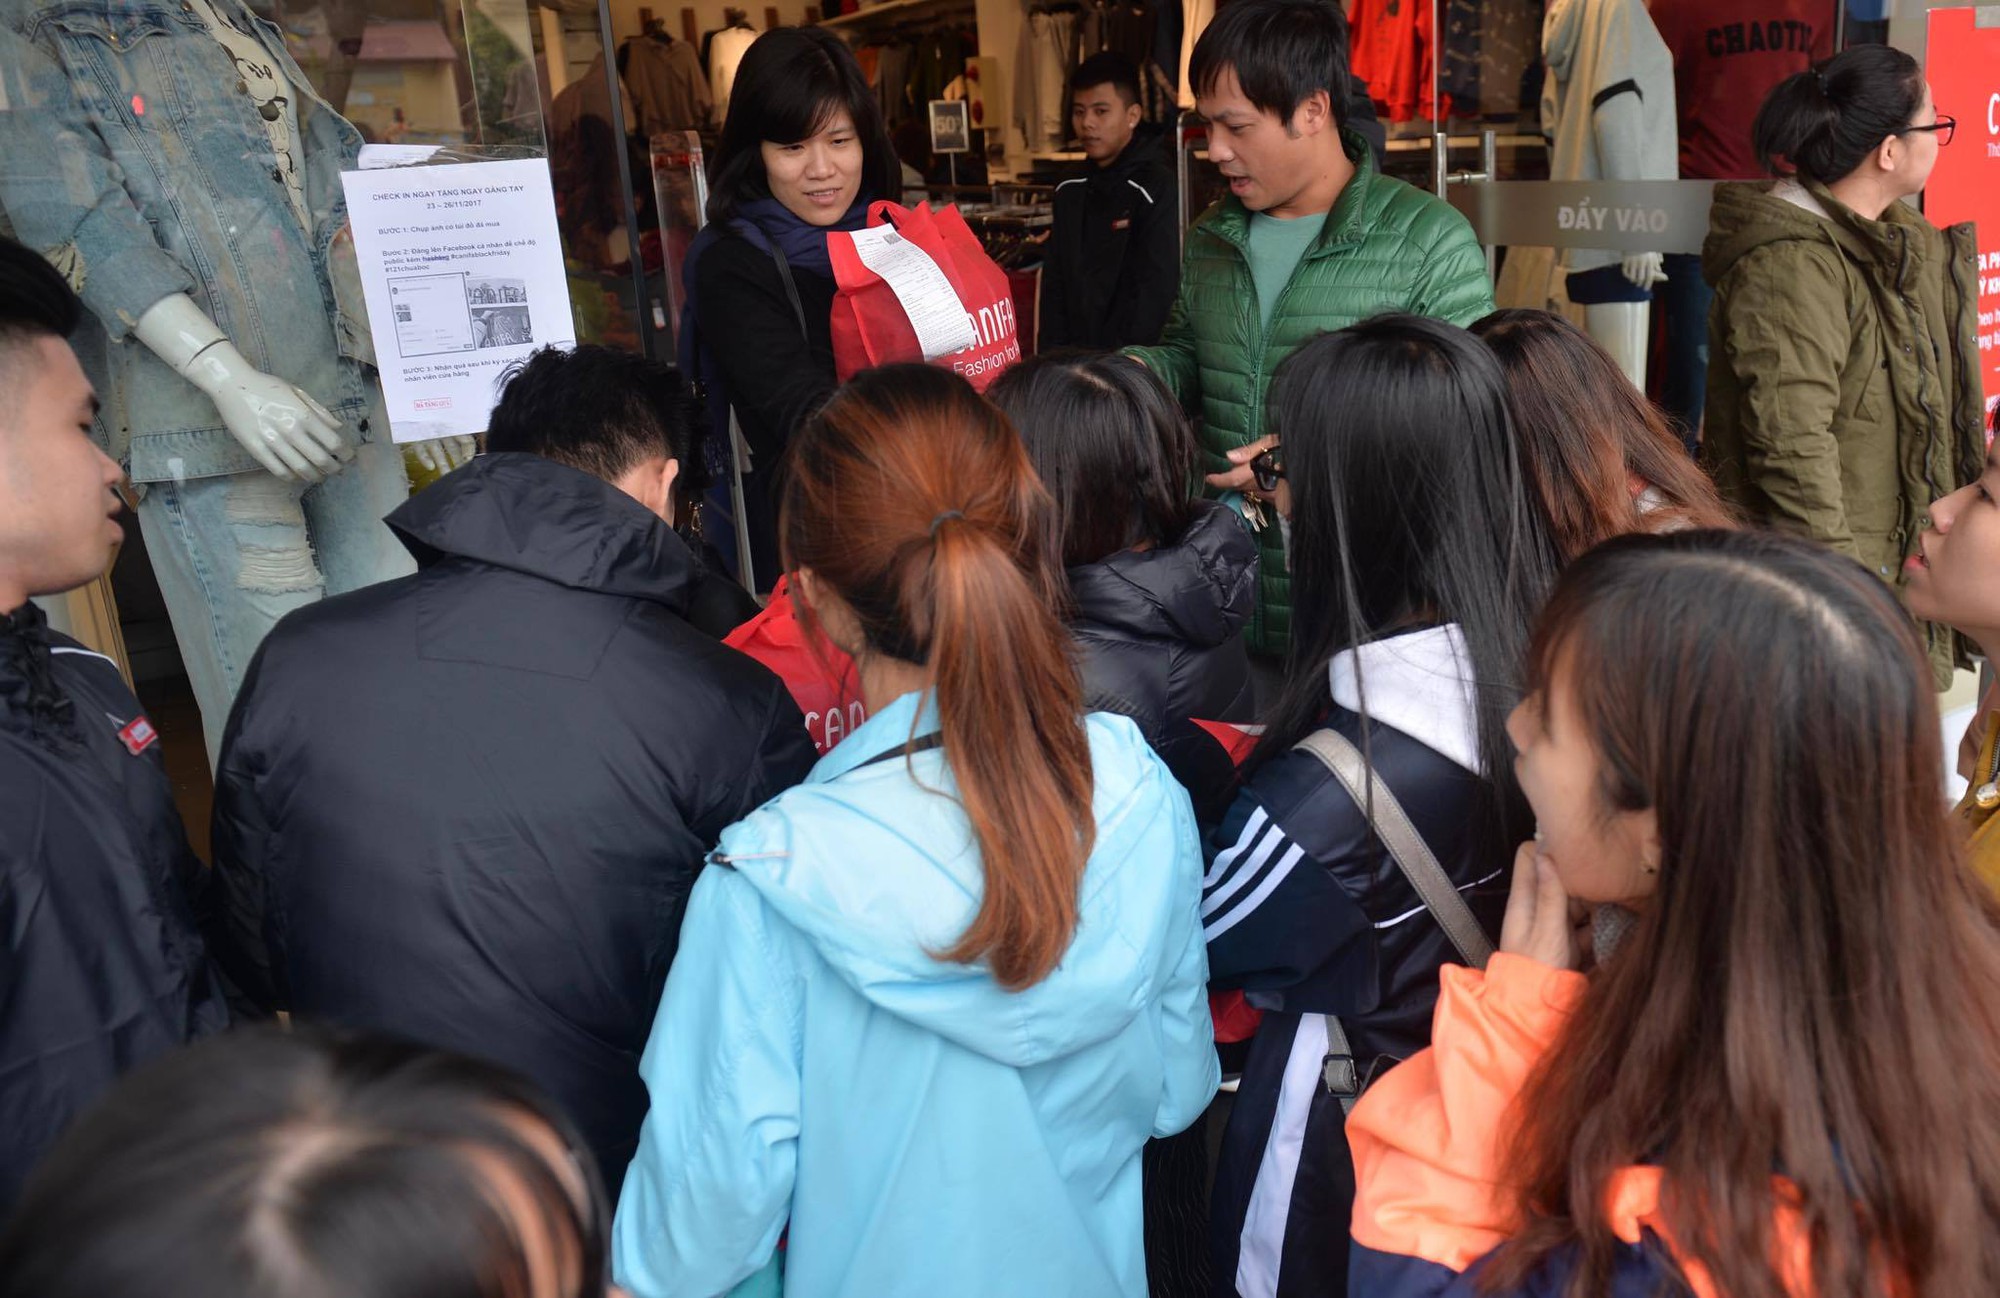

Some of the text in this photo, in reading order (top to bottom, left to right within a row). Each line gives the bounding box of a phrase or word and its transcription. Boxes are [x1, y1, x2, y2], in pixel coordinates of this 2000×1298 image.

[372, 192, 401, 201] CHECK
[402, 191, 411, 199] IN
[412, 190, 435, 199] NGAY
[461, 187, 483, 196] NGAY
[509, 184, 524, 192] TAY
[443, 200, 482, 208] 26/11/2017
[1557, 195, 1669, 233] ĐẨY VÀO
[443, 244, 476, 252] Facebook
[384, 257, 405, 265] public
[955, 297, 1015, 354] ANIFA
[953, 351, 1006, 377] Fashion
